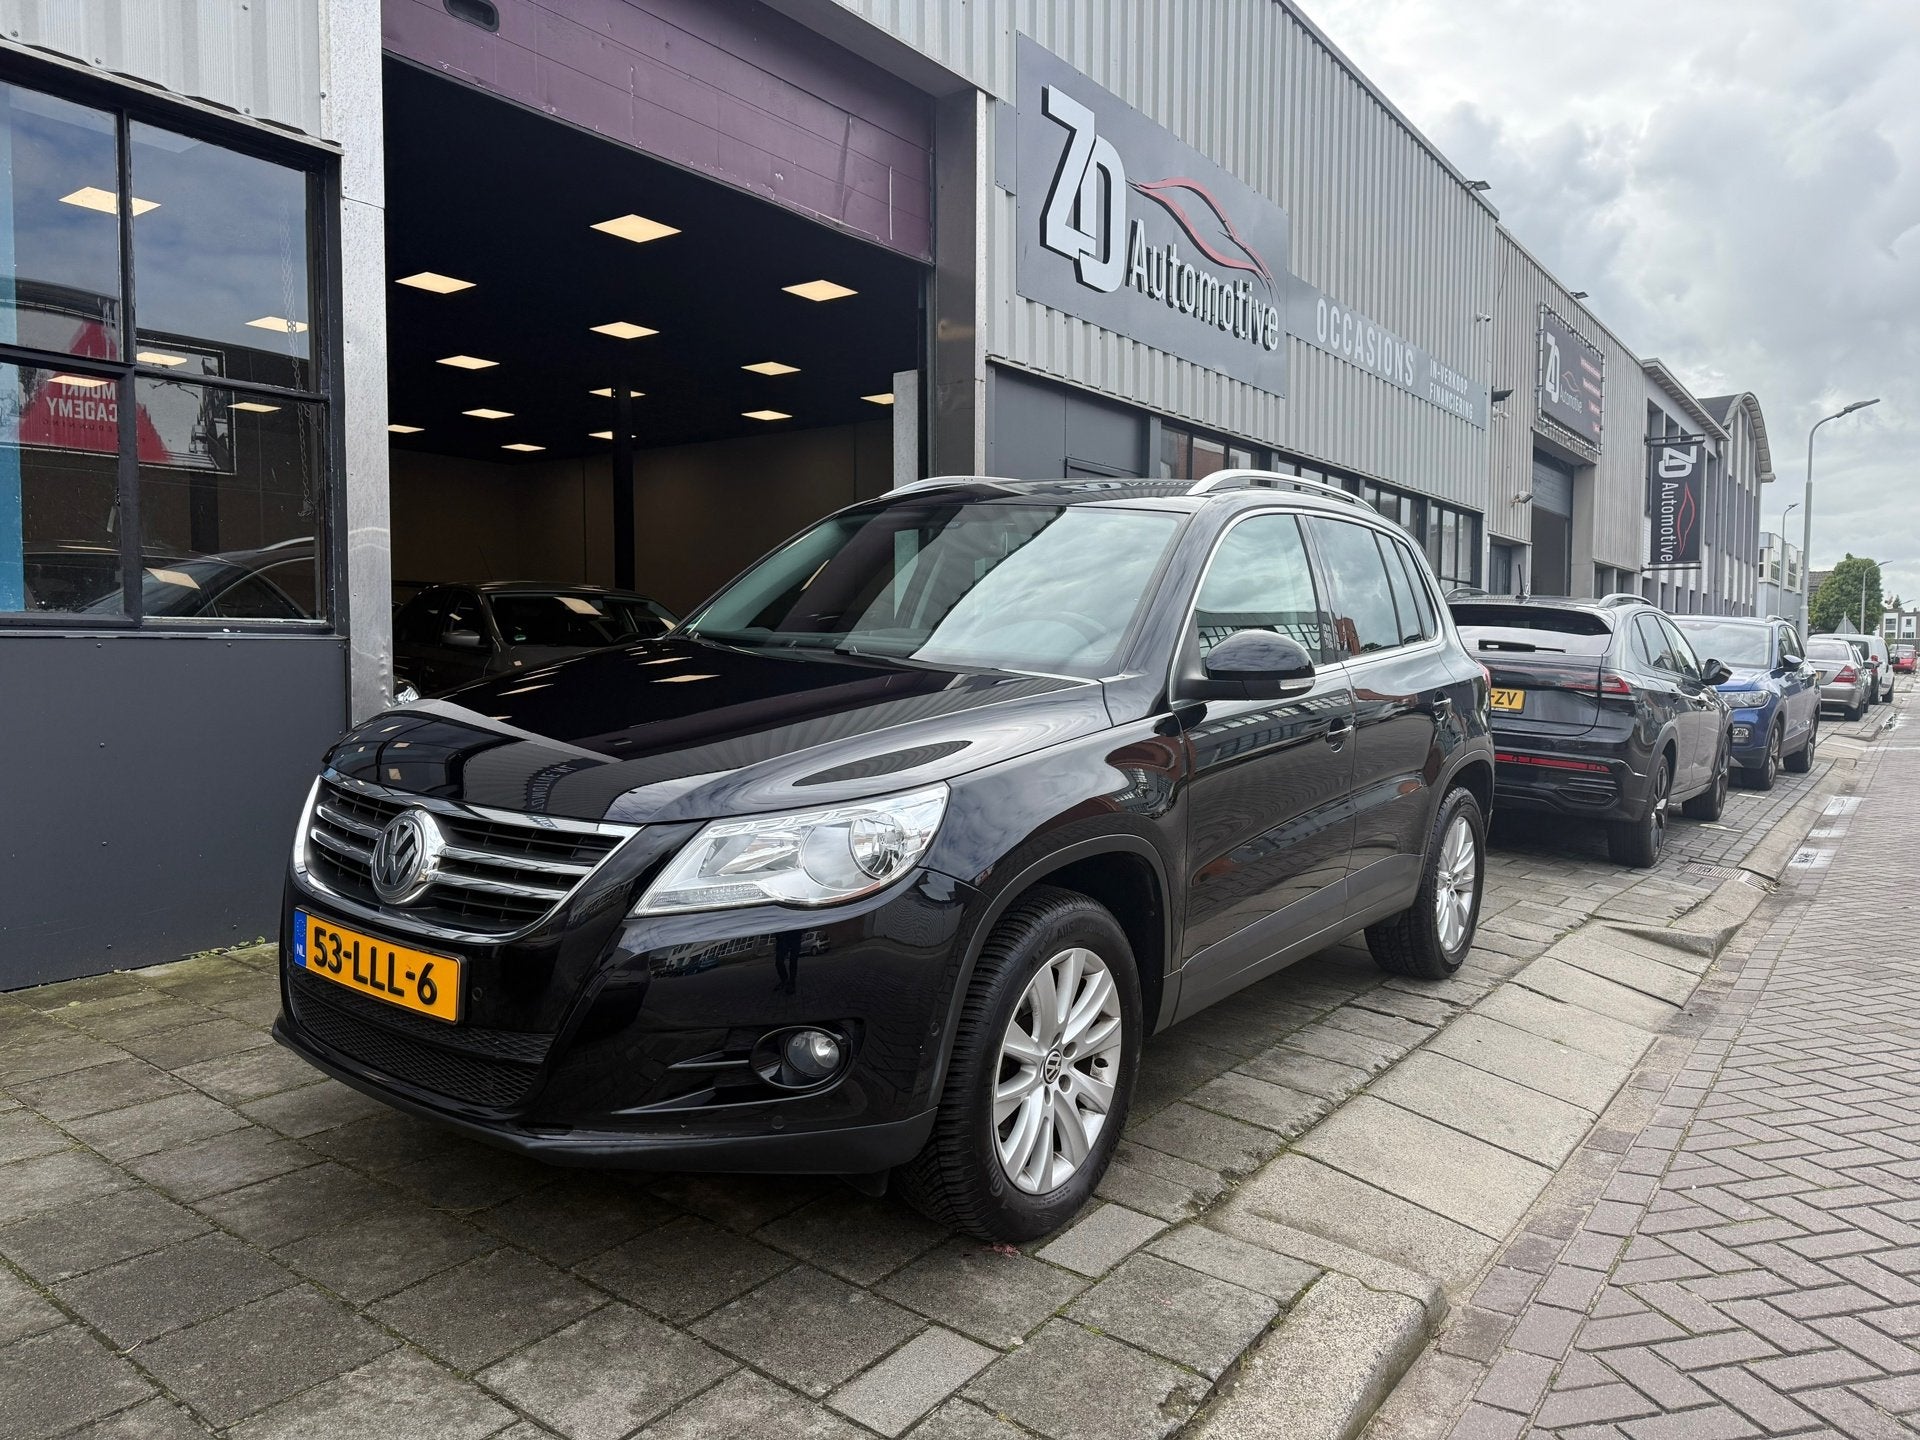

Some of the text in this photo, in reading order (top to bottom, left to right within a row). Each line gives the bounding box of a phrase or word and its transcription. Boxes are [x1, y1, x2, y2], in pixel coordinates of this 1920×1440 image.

[1040, 84, 1126, 293] ZD
[1126, 217, 1280, 351] Automotive
[1316, 298, 1414, 387] OCCASIONS
[1429, 382, 1474, 420] FINANCIERING
[1658, 445, 1698, 562] ZD Automotive
[296, 943, 305, 958] NL
[313, 925, 438, 1006] 53-LLL-6
